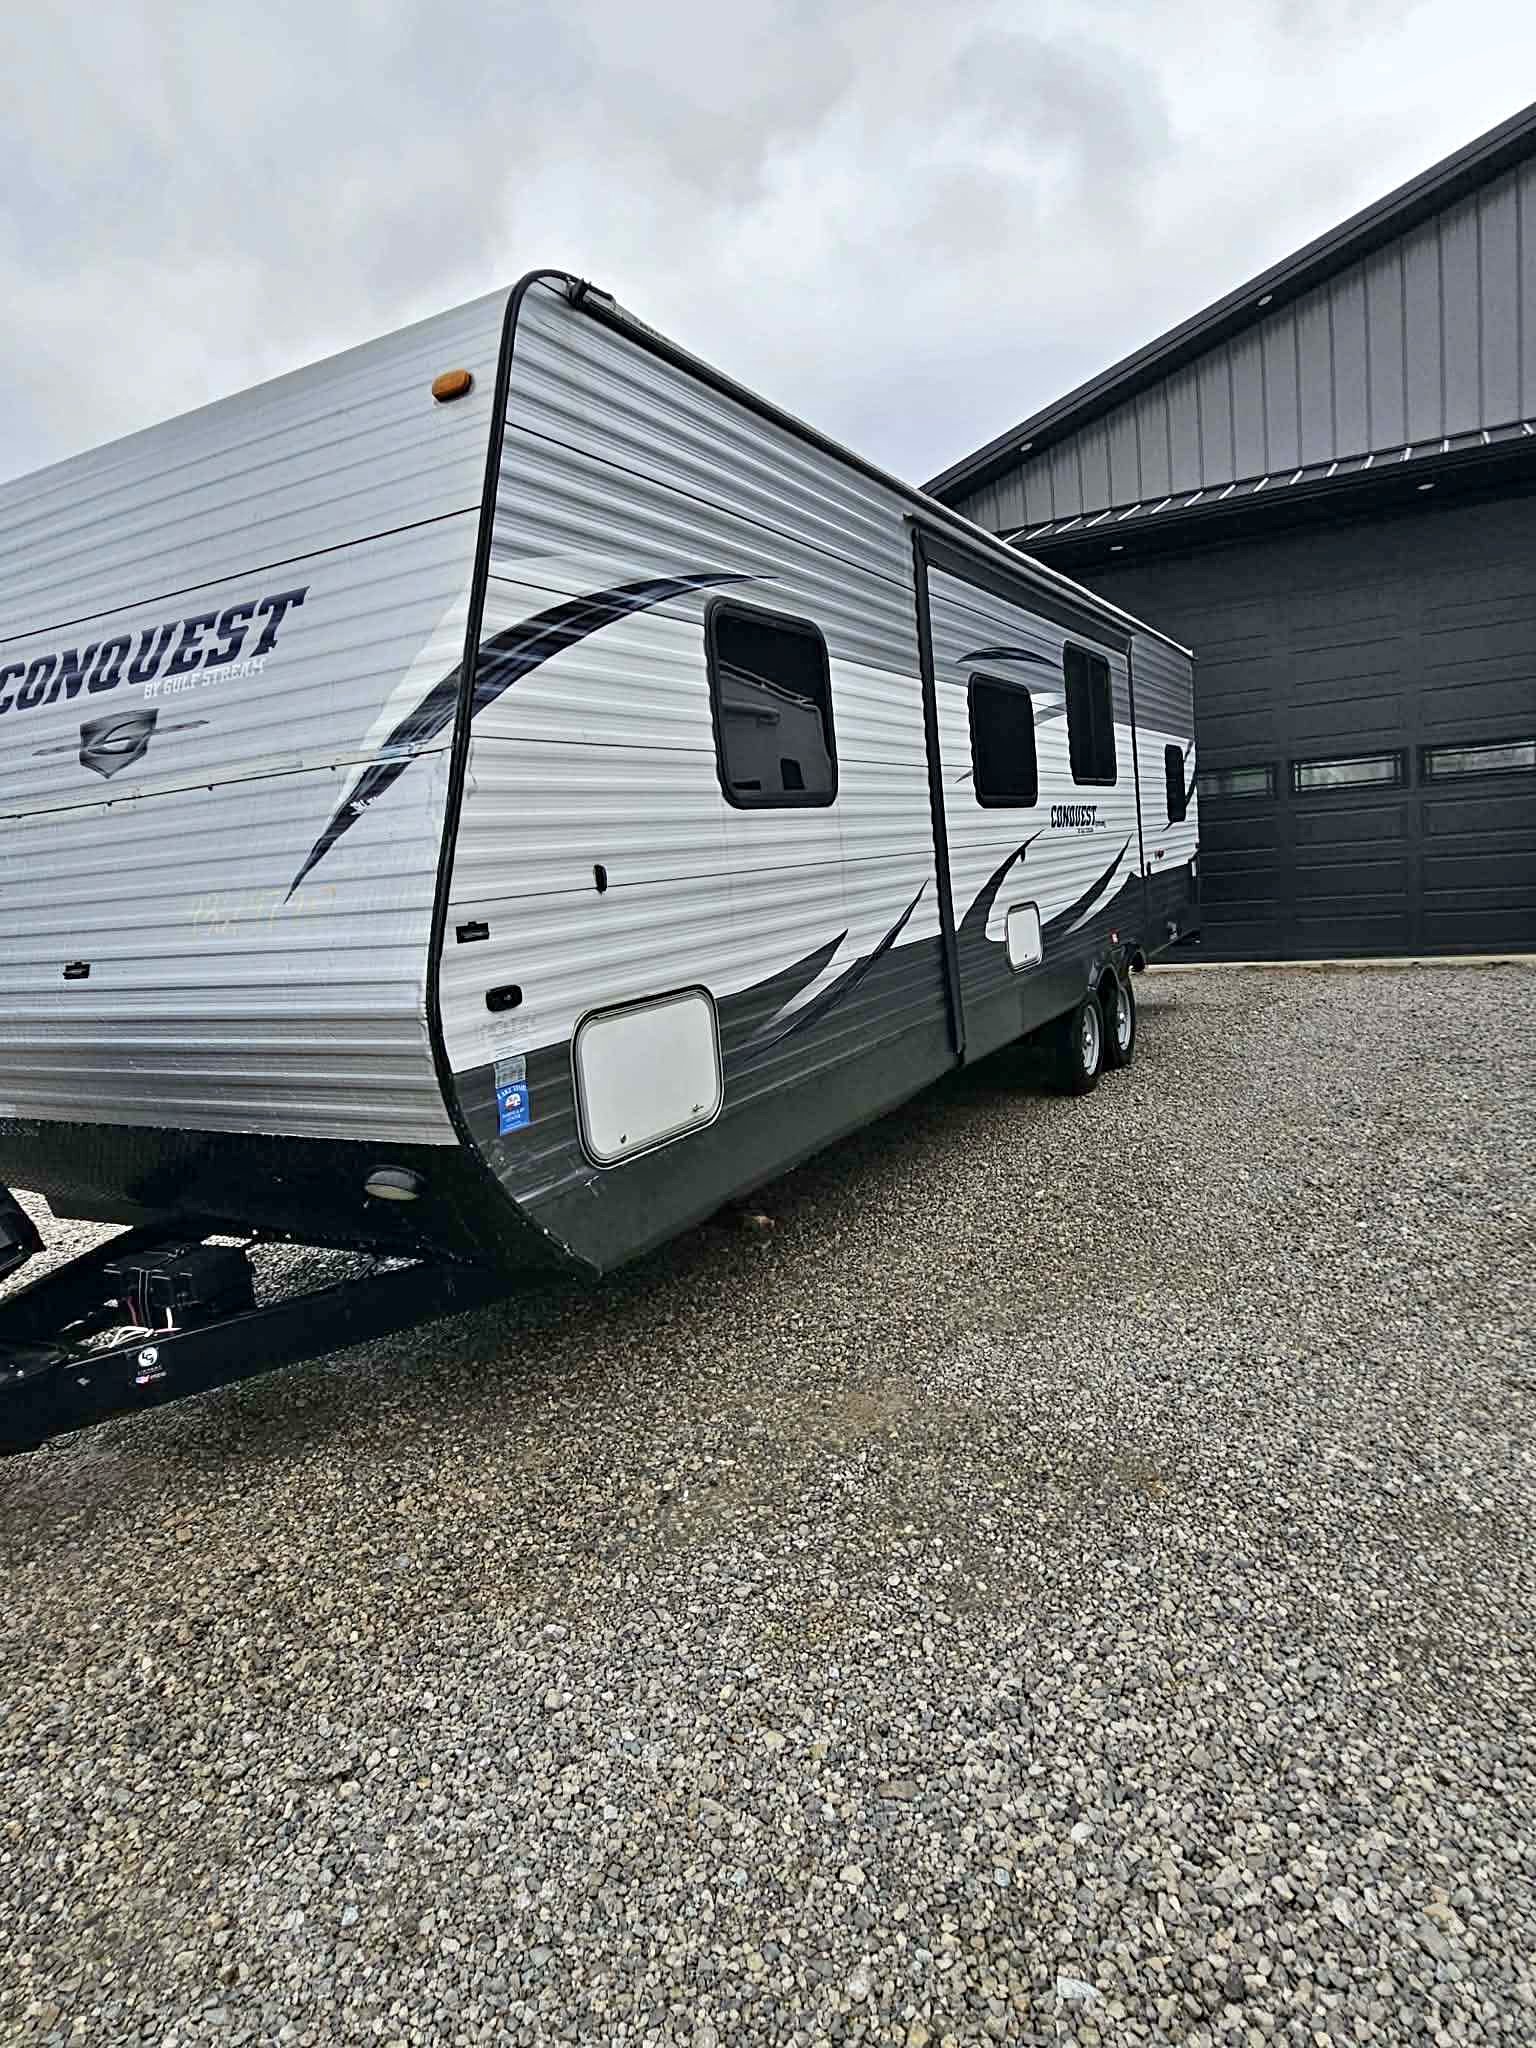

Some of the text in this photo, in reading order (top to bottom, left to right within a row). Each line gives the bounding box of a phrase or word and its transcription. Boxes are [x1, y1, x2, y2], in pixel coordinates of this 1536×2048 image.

[0, 586, 310, 714] CONQUEST
[144, 657, 267, 699] BY GULF STREAM
[1051, 805, 1097, 828] CONQUEST
